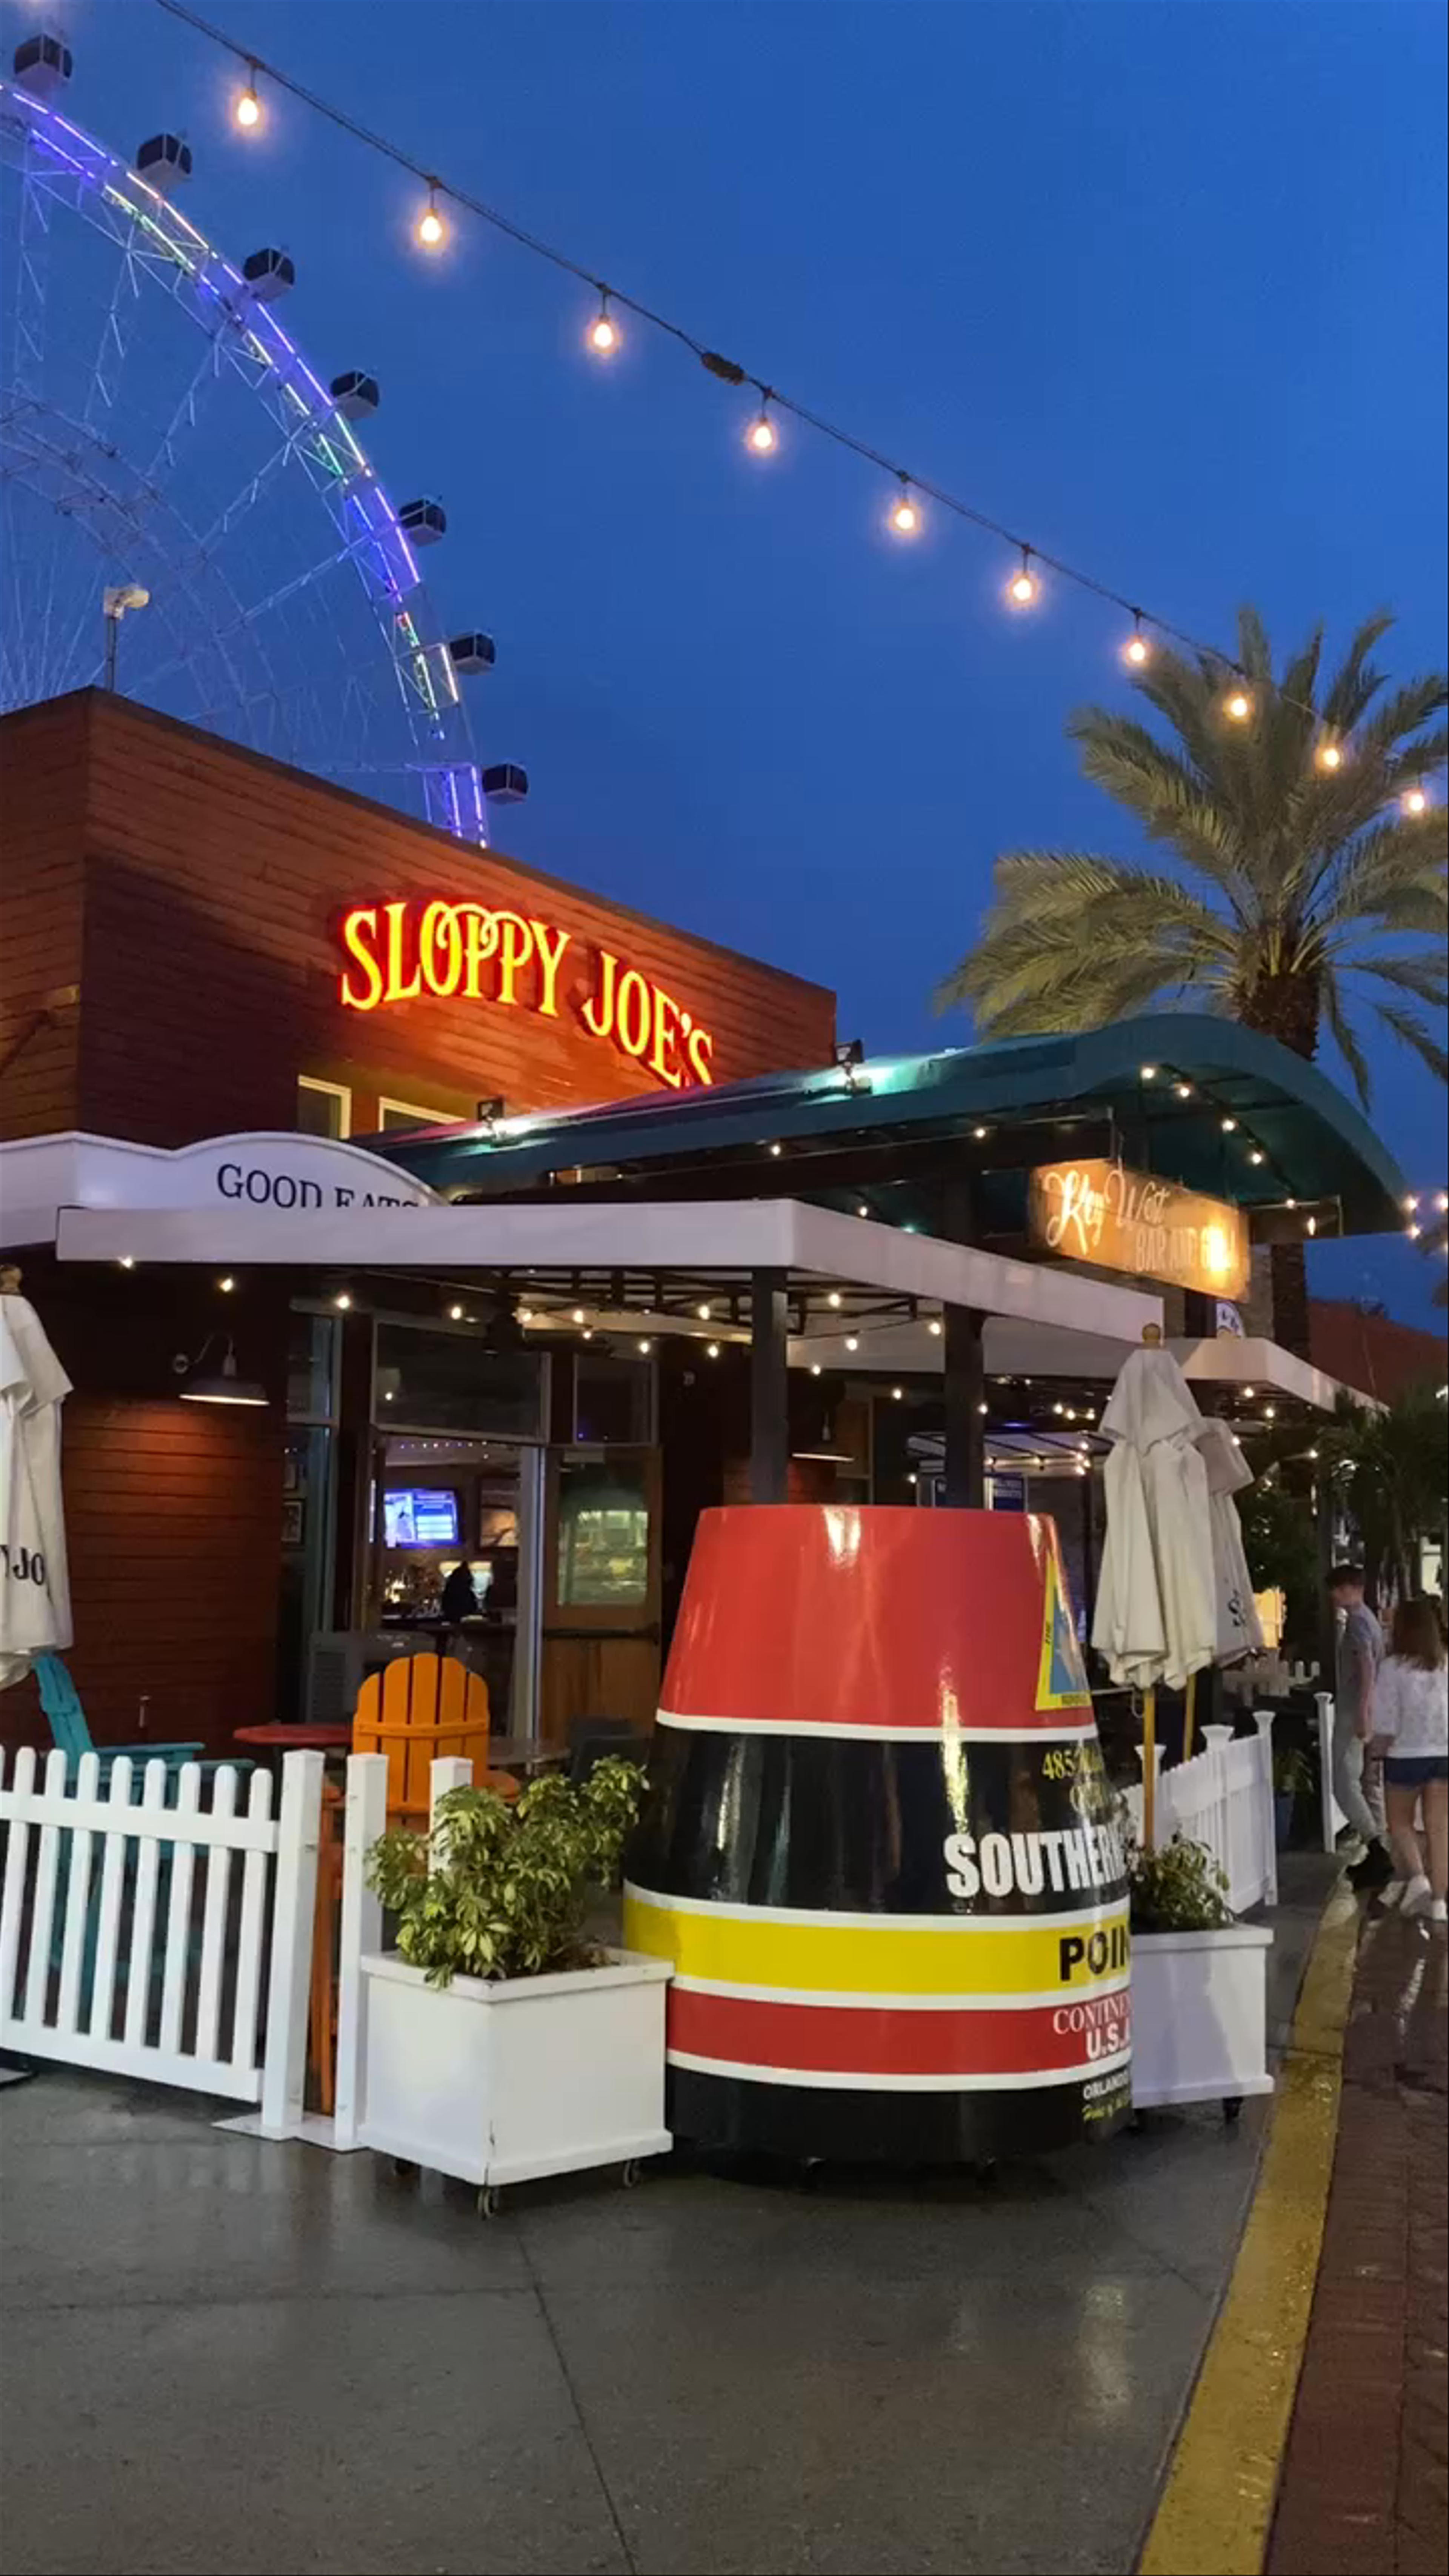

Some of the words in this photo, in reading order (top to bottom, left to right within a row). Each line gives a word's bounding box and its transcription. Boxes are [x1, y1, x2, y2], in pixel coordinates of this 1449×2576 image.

[341, 901, 571, 1017] SLOPPY
[582, 950, 712, 1087] JOE'S
[217, 1164, 322, 1208] GOOD
